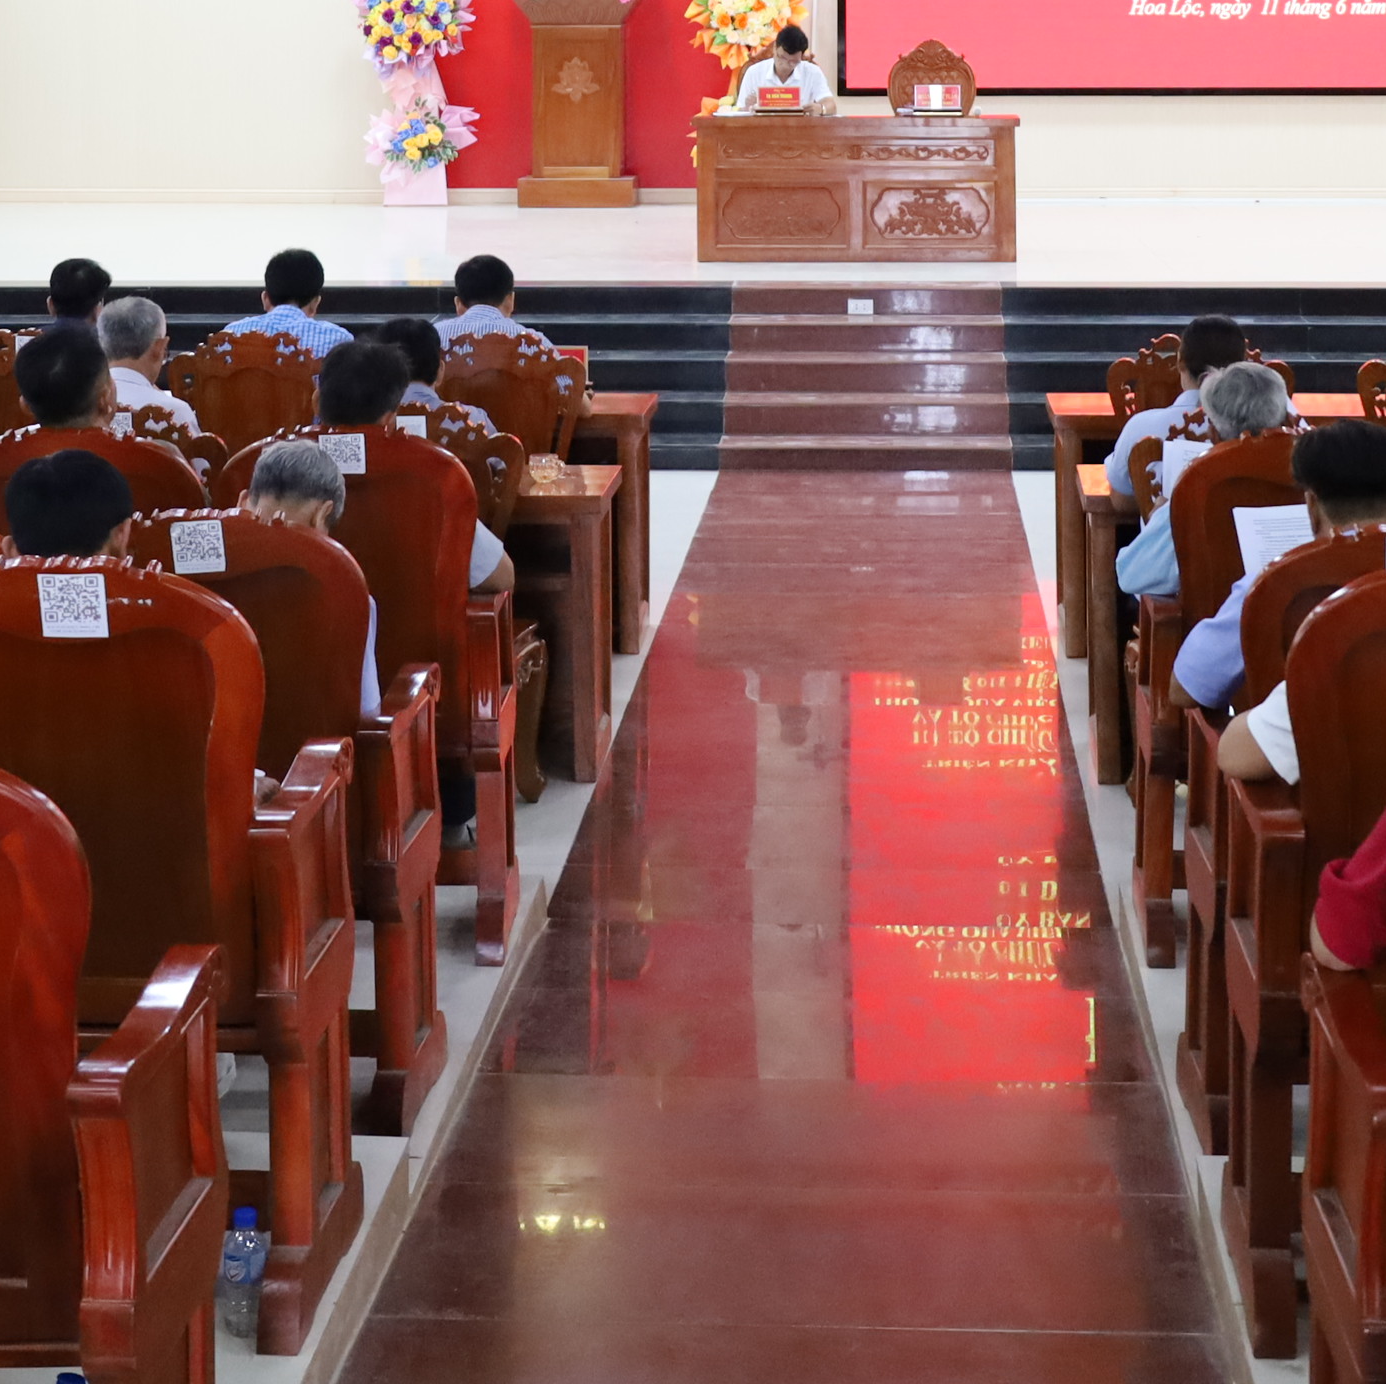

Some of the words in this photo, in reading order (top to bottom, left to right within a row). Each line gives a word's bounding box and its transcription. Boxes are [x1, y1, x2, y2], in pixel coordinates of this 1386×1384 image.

[1129, 0, 1166, 15] Hoa
[1169, 0, 1204, 18] Lộc,
[1350, 0, 1386, 14] năm
